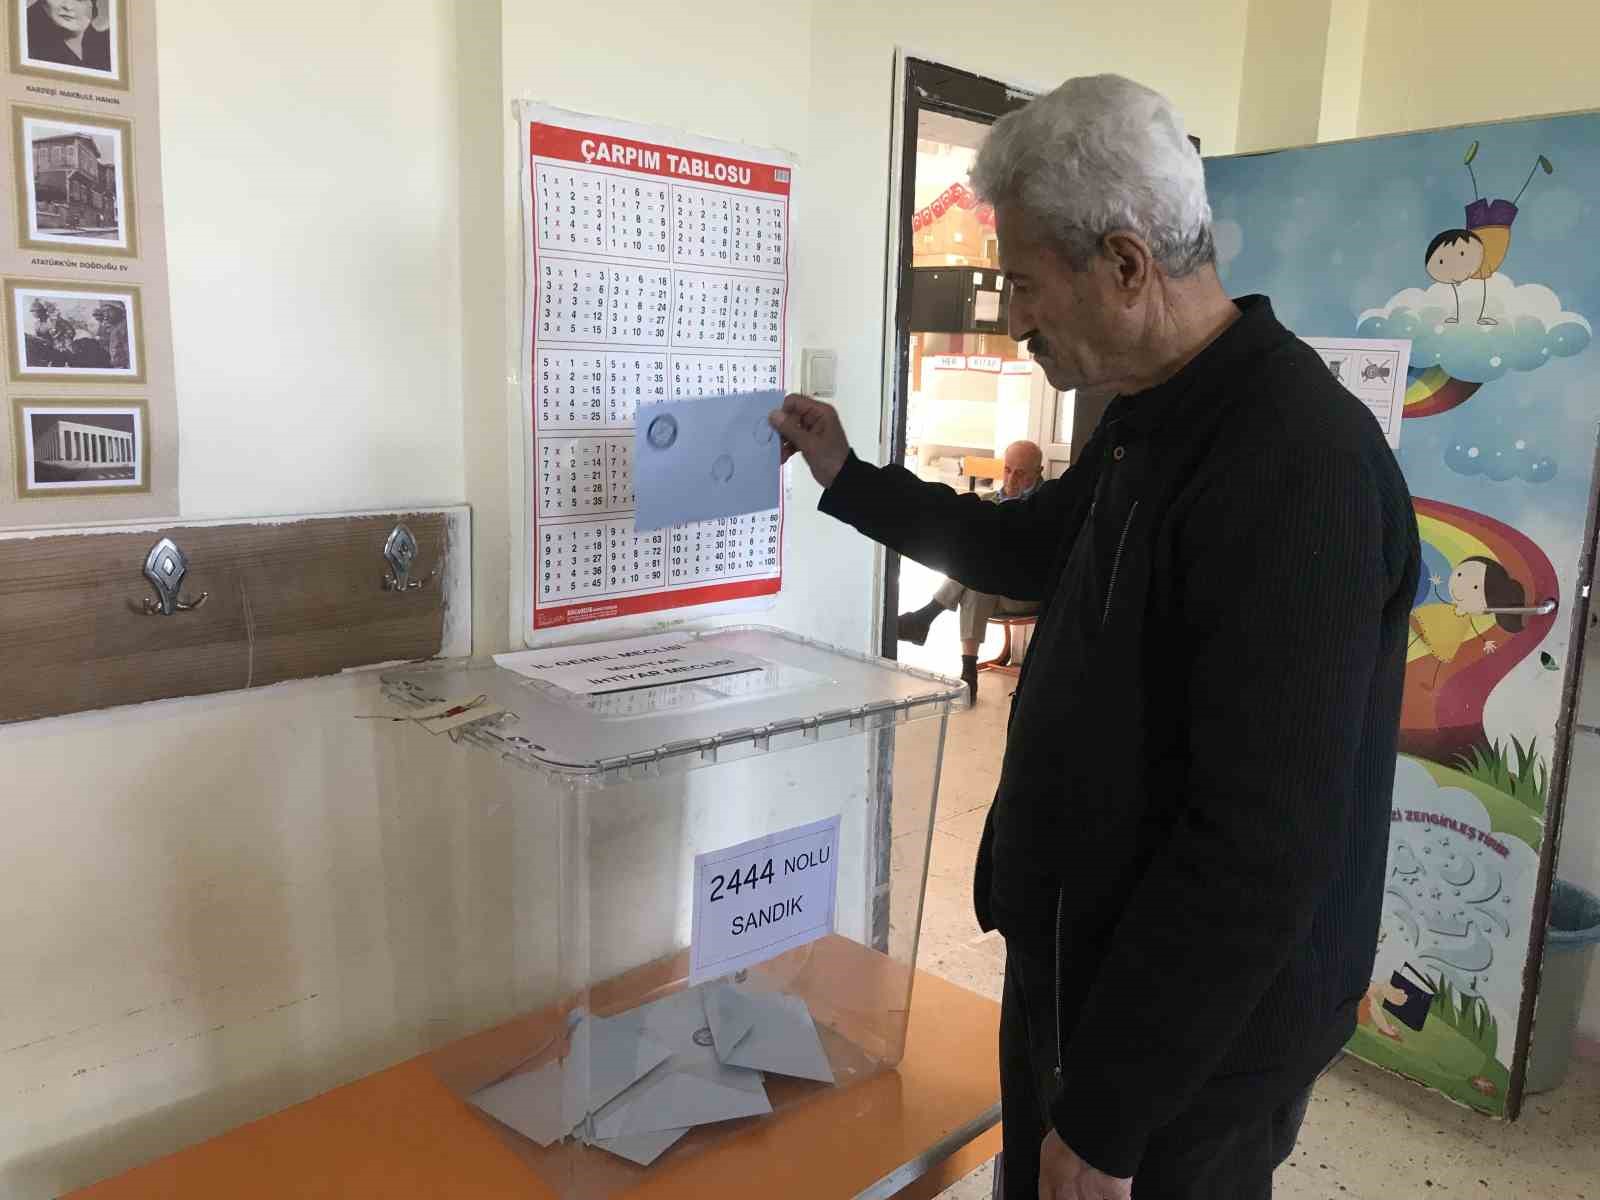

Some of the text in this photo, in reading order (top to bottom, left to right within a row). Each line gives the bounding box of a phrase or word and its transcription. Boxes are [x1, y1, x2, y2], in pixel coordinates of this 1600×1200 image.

[580, 139, 751, 185] ÇARPIM TABLOSU
[542, 174, 601, 190] 1 1 1
[544, 188, 601, 204] 1 2 2
[612, 184, 664, 200] 1 6 6
[545, 202, 601, 218] 1 3 3
[612, 198, 664, 213] 1 7 7
[545, 216, 601, 231] 1 4 4
[612, 212, 665, 226] 1 8 8
[545, 231, 601, 245] 1 5 5
[612, 225, 665, 240] 1 9 9
[612, 239, 616, 247] 1
[657, 244, 665, 252] 10
[546, 266, 604, 280] 3 1 3
[547, 281, 551, 289] 3
[573, 283, 578, 291] 2
[546, 295, 603, 307] 3 3 9
[545, 309, 602, 320] 3 4 12
[544, 323, 601, 334] 3 5 15
[544, 358, 548, 366] 5
[635, 361, 640, 369] 6
[655, 361, 663, 369] 30
[544, 372, 548, 380] 5
[592, 373, 600, 381] 10
[544, 386, 600, 394] 5 3 15
[544, 399, 548, 407] 5
[570, 399, 574, 407] 4
[544, 412, 548, 420] 5
[544, 447, 548, 455] 7
[544, 460, 549, 468] 7
[570, 460, 575, 468] 2
[571, 472, 576, 480] 3
[545, 484, 602, 495] 7 4 28
[545, 497, 602, 508] 7 5 35
[546, 529, 601, 542] 9 1 9
[546, 542, 601, 555] 9 2 18
[612, 540, 616, 548] 9
[546, 555, 601, 568] 9 3 27
[612, 553, 616, 561] 9
[545, 567, 601, 580] 9 4 36
[612, 565, 616, 573] 9
[611, 571, 660, 585] 9 10 90
[545, 579, 601, 593] 9 5 45
[555, 655, 618, 666] GENEL
[709, 845, 830, 903] 2444 NOLU
[731, 894, 803, 936] SANDIK
